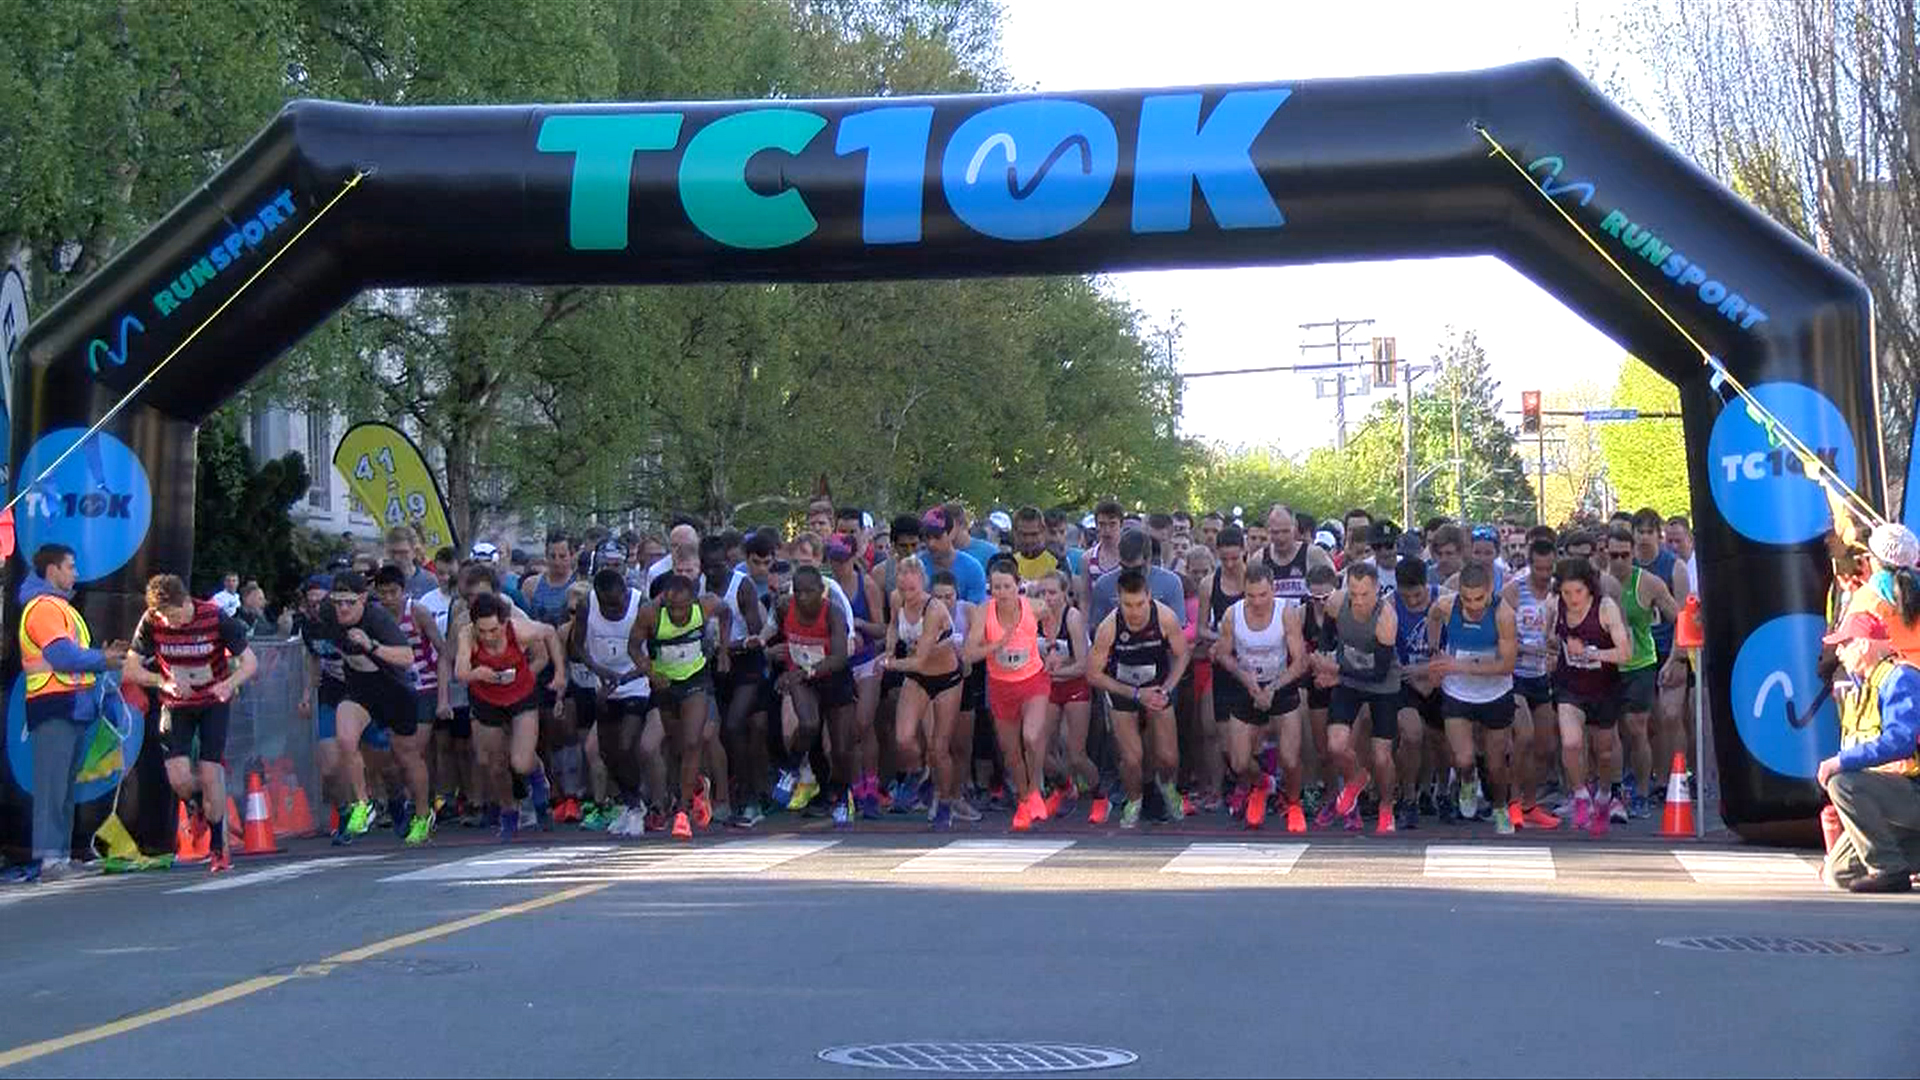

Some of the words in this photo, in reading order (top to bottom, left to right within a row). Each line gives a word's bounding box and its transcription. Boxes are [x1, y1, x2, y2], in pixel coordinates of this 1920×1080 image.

[537, 89, 1293, 251] TC10K
[153, 189, 297, 316] RUNSPORT
[1600, 209, 1768, 329] RUNSPORT
[354, 447, 396, 482] 41
[384, 492, 428, 527] 49
